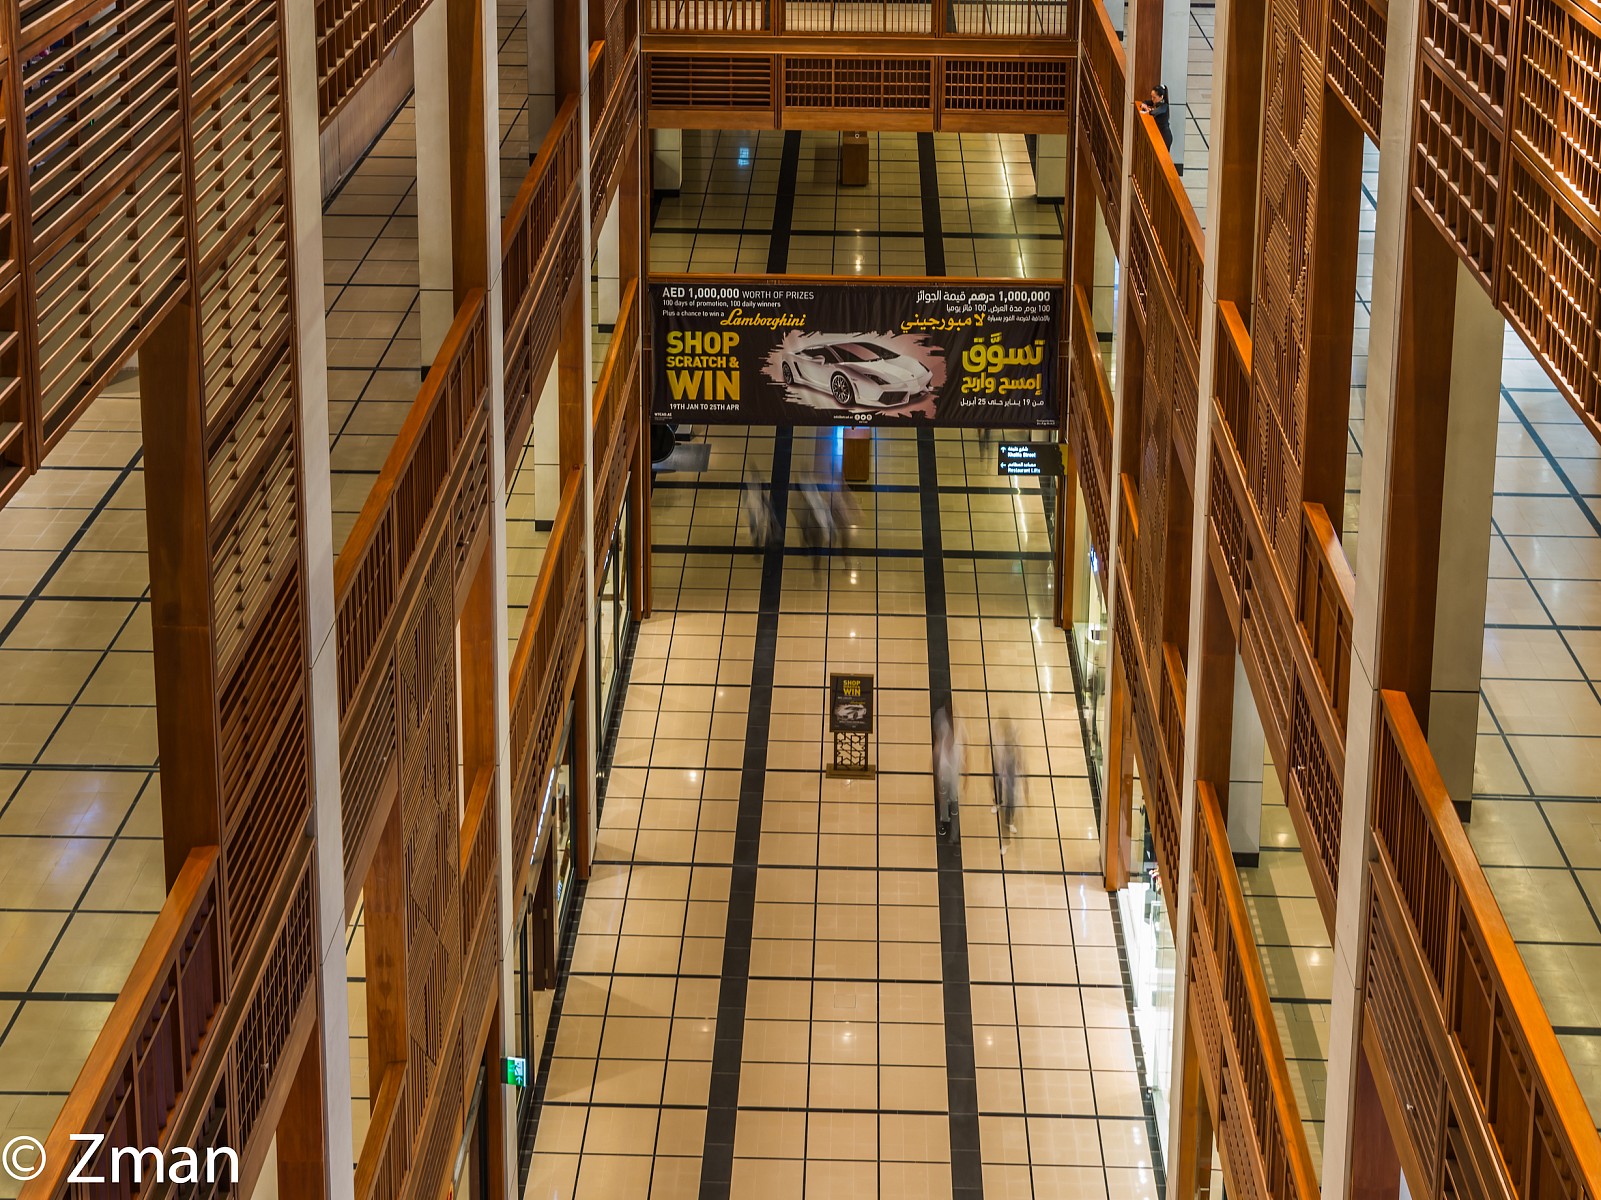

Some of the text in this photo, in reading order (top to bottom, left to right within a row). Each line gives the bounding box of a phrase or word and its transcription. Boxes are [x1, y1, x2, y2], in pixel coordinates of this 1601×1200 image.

[662, 287, 815, 300] AED 1,000,000 WORTH OF PRIZES
[915, 290, 1050, 305] 1,000,000 درهم قيمة الجوائز
[674, 299, 688, 307] days
[696, 300, 729, 308] promotion,
[742, 300, 756, 308] daily
[974, 304, 986, 312] 100
[1009, 304, 1022, 312] مدة
[1023, 306, 1037, 314] يوم
[1038, 304, 1050, 312] 100
[662, 309, 675, 317] Plus
[720, 308, 807, 331] Lamborghini
[666, 330, 740, 355] SHOP
[666, 355, 740, 368] SCRATCH &
[666, 369, 740, 401] WIN
[1023, 398, 1031, 406] 19
[1031, 399, 1044, 407] من
[709, 403, 725, 411] 25TH
[726, 403, 740, 411] APR
[843, 688, 861, 696] WIN
